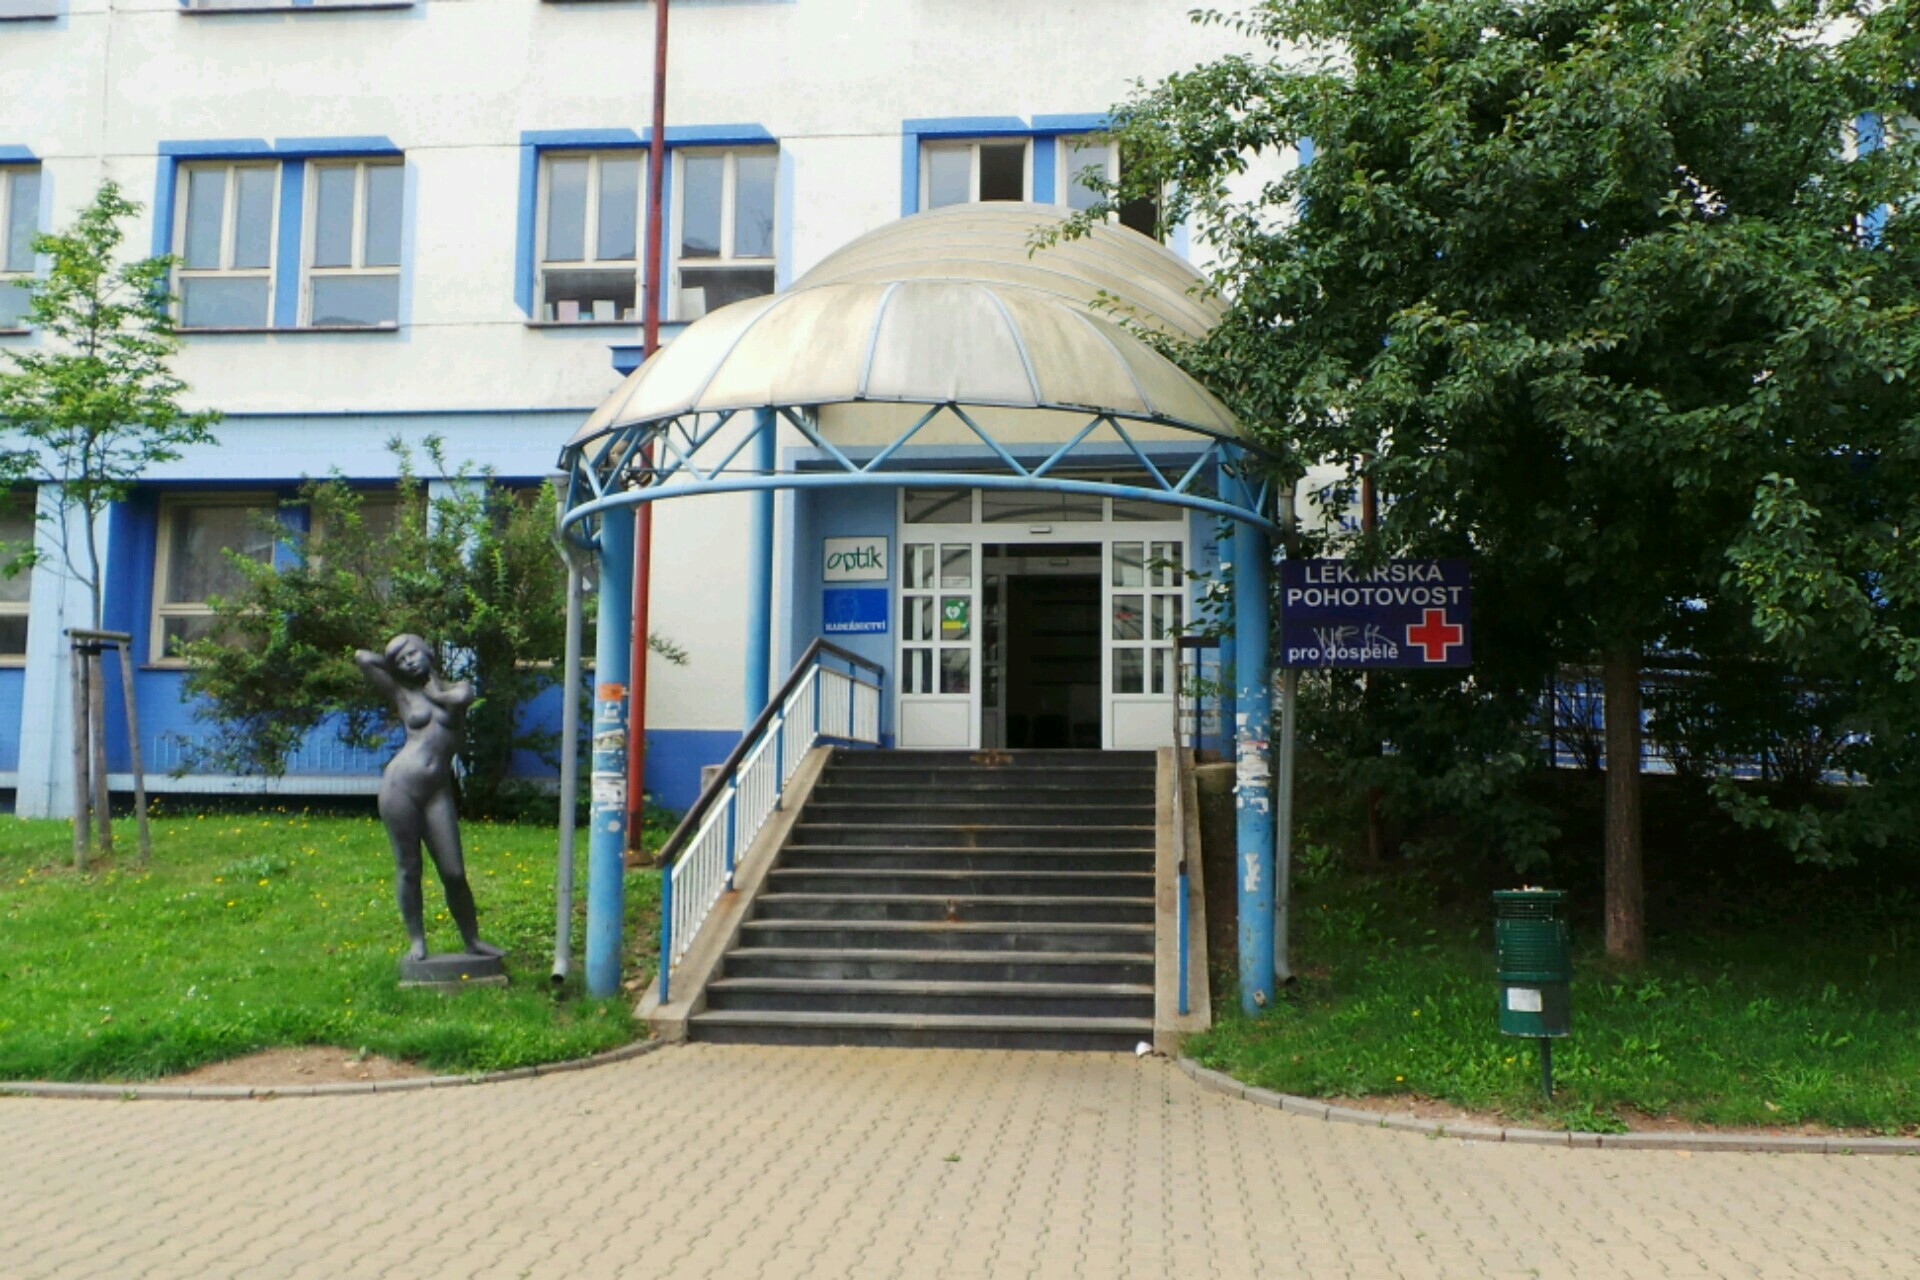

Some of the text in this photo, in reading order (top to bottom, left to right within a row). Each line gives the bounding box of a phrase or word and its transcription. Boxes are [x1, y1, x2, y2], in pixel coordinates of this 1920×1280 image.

[827, 545, 884, 572] optik
[1287, 586, 1463, 607] POHOTOVOST
[1288, 647, 1320, 663] pro
